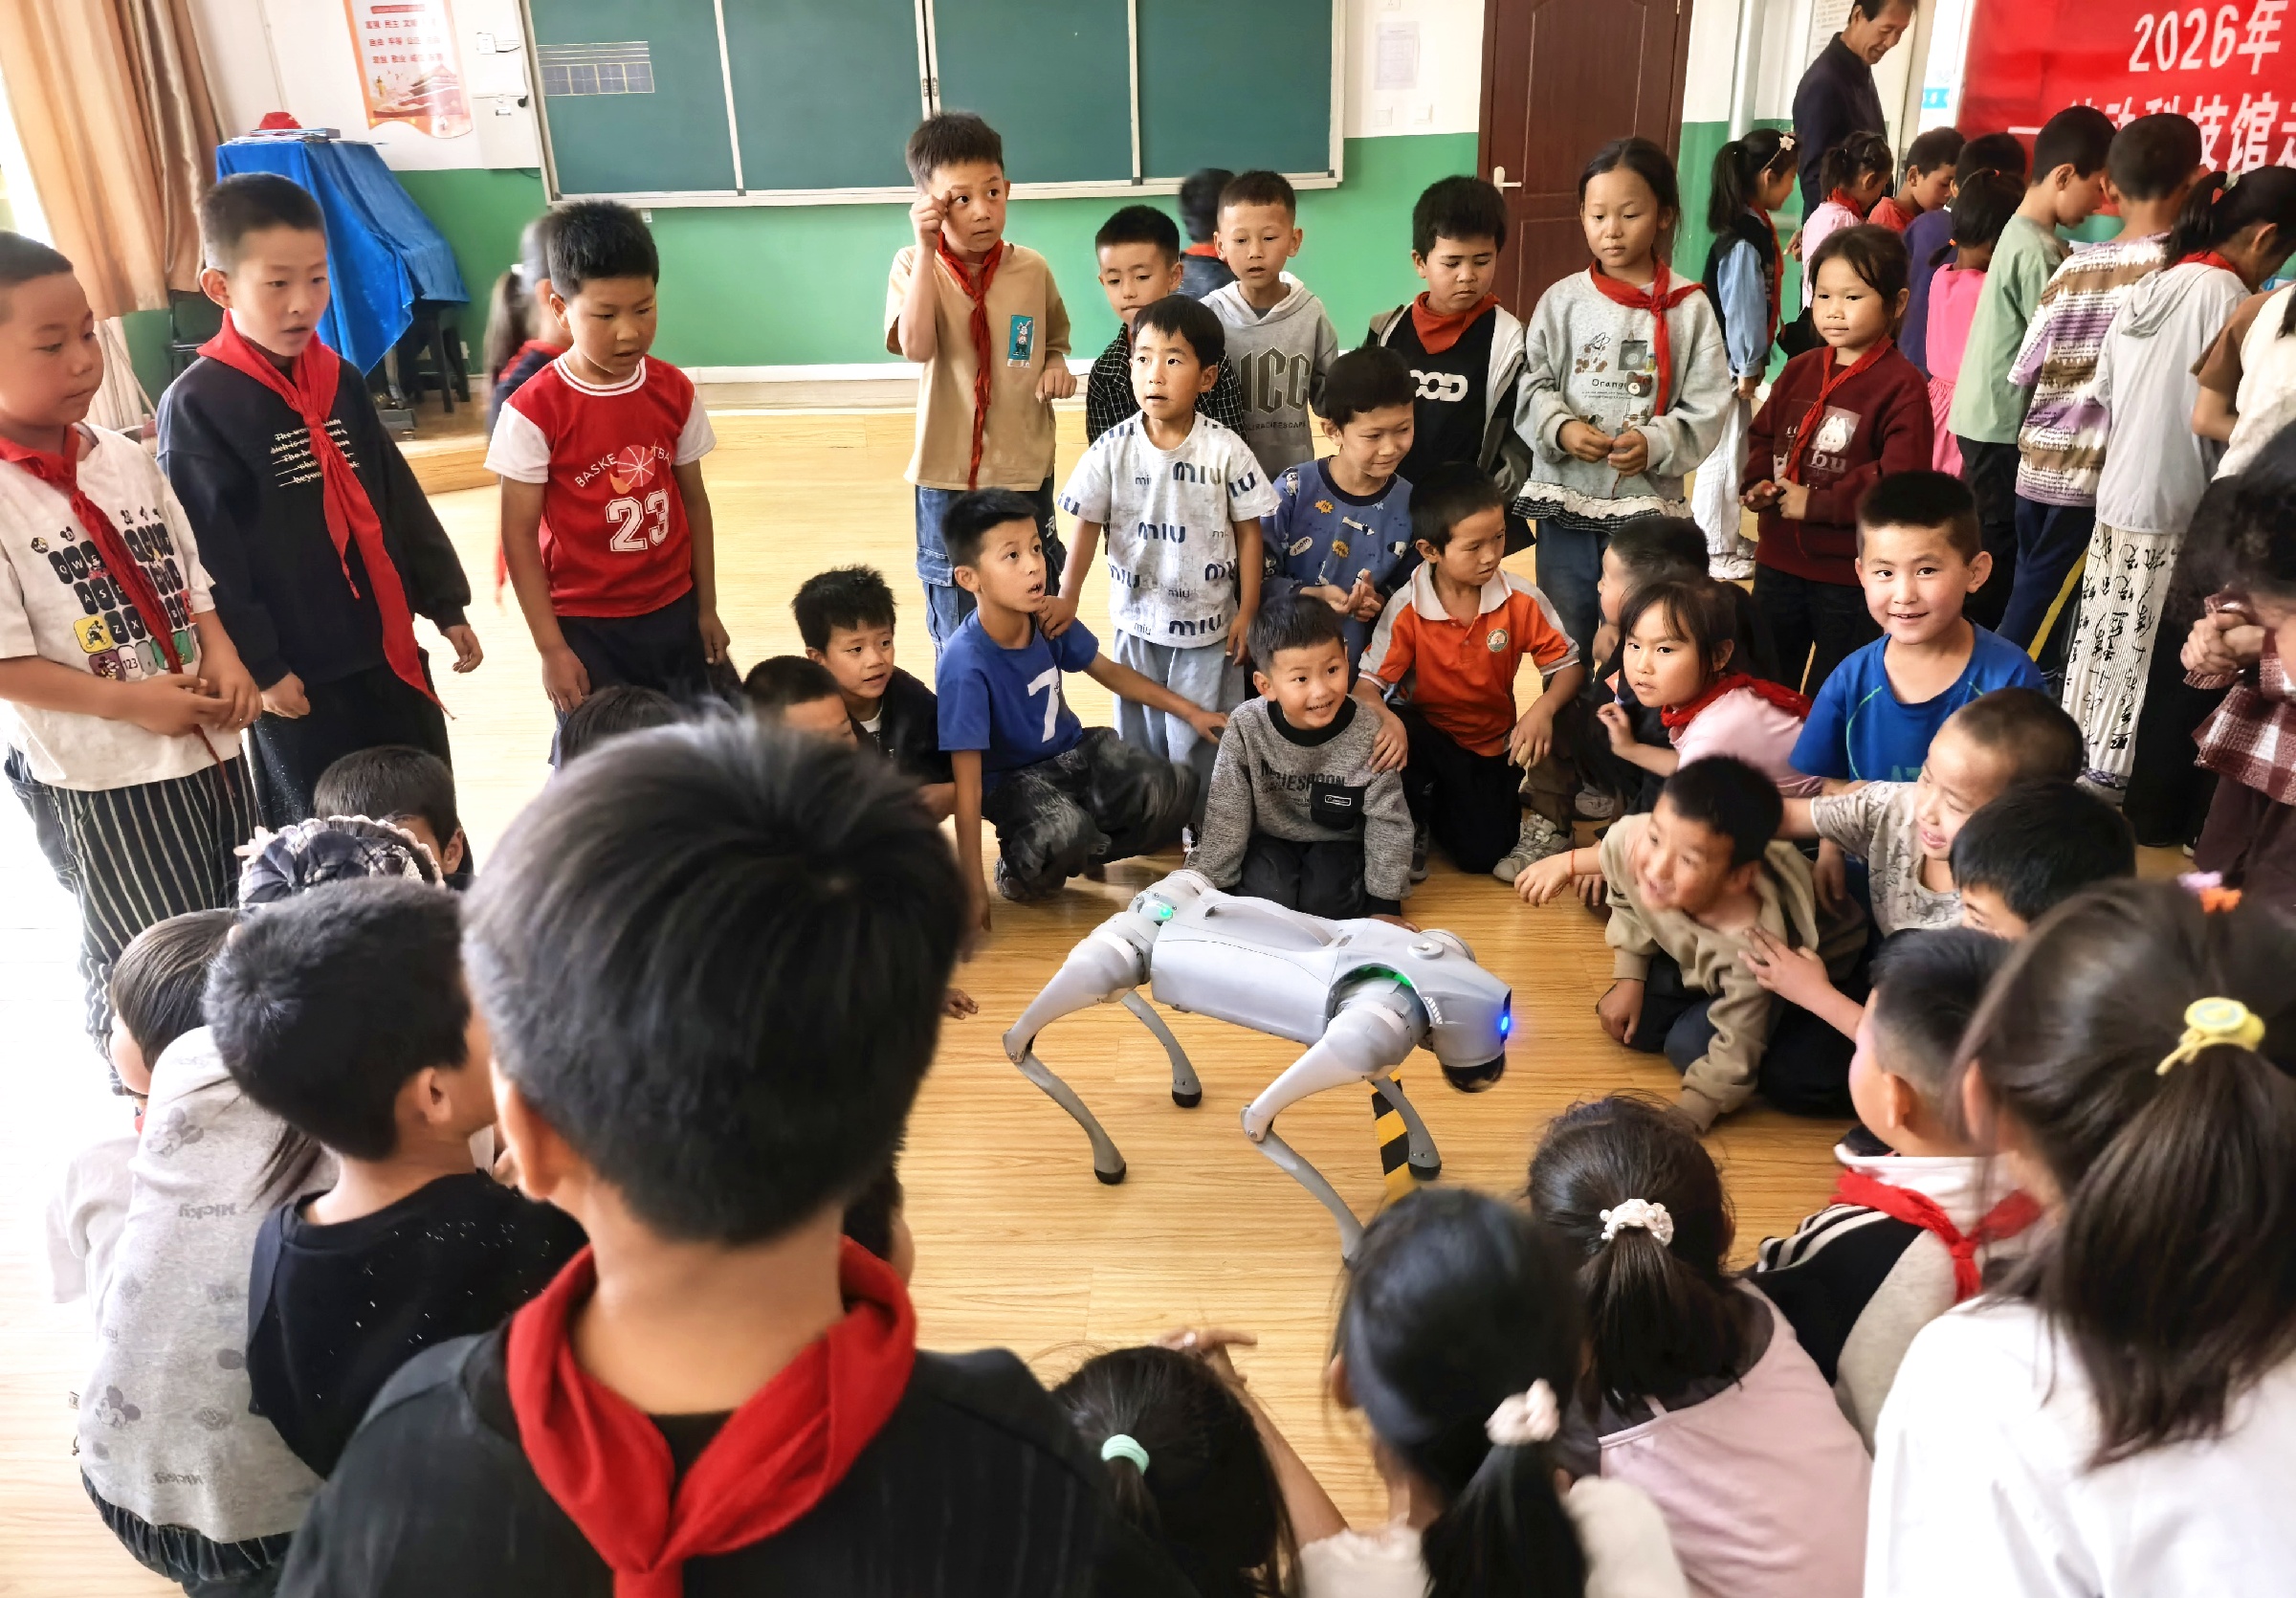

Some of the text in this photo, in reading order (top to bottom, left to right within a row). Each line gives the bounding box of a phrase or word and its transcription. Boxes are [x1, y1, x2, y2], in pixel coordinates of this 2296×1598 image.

[2129, 0, 2288, 76] 2026年
[1592, 378, 1626, 389] Orang
[605, 489, 670, 551] 23
[122, 658, 139, 669] 123
[1027, 665, 1060, 743] 7
